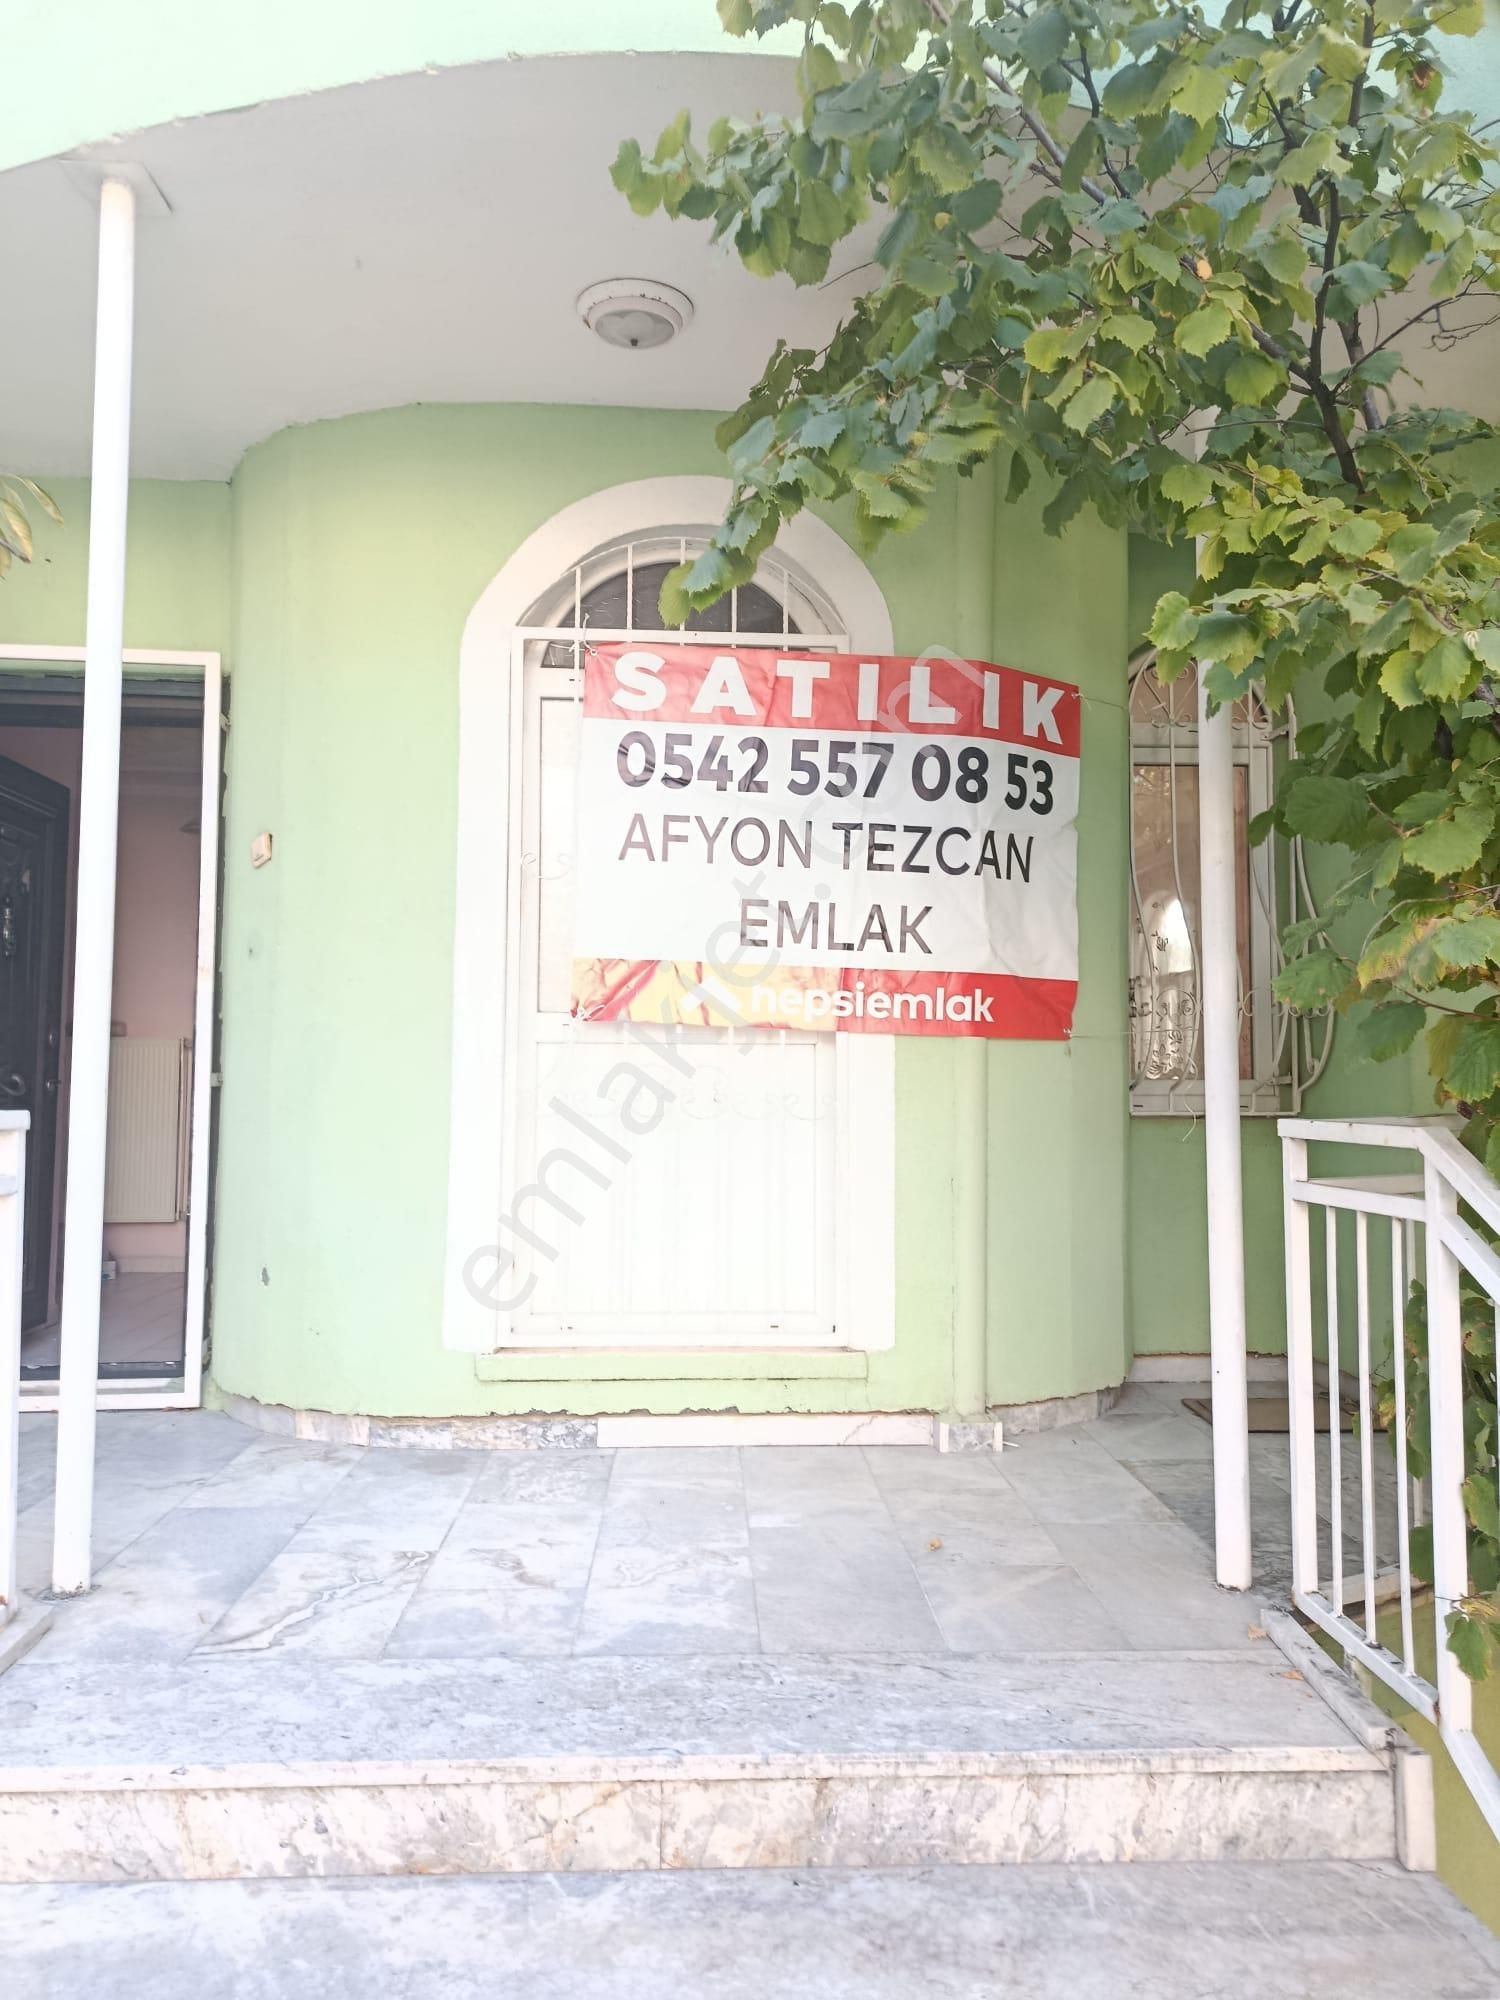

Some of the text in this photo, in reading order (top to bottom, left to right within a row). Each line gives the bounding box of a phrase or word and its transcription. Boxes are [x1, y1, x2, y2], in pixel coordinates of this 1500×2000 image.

[612, 651, 1064, 745] SATILIK
[617, 731, 1054, 816] 0542 557 08 53
[618, 812, 1034, 884] AFYON TEZCAN
[739, 898, 933, 955] EMLAK
[752, 981, 994, 1023] hepsiemlak
